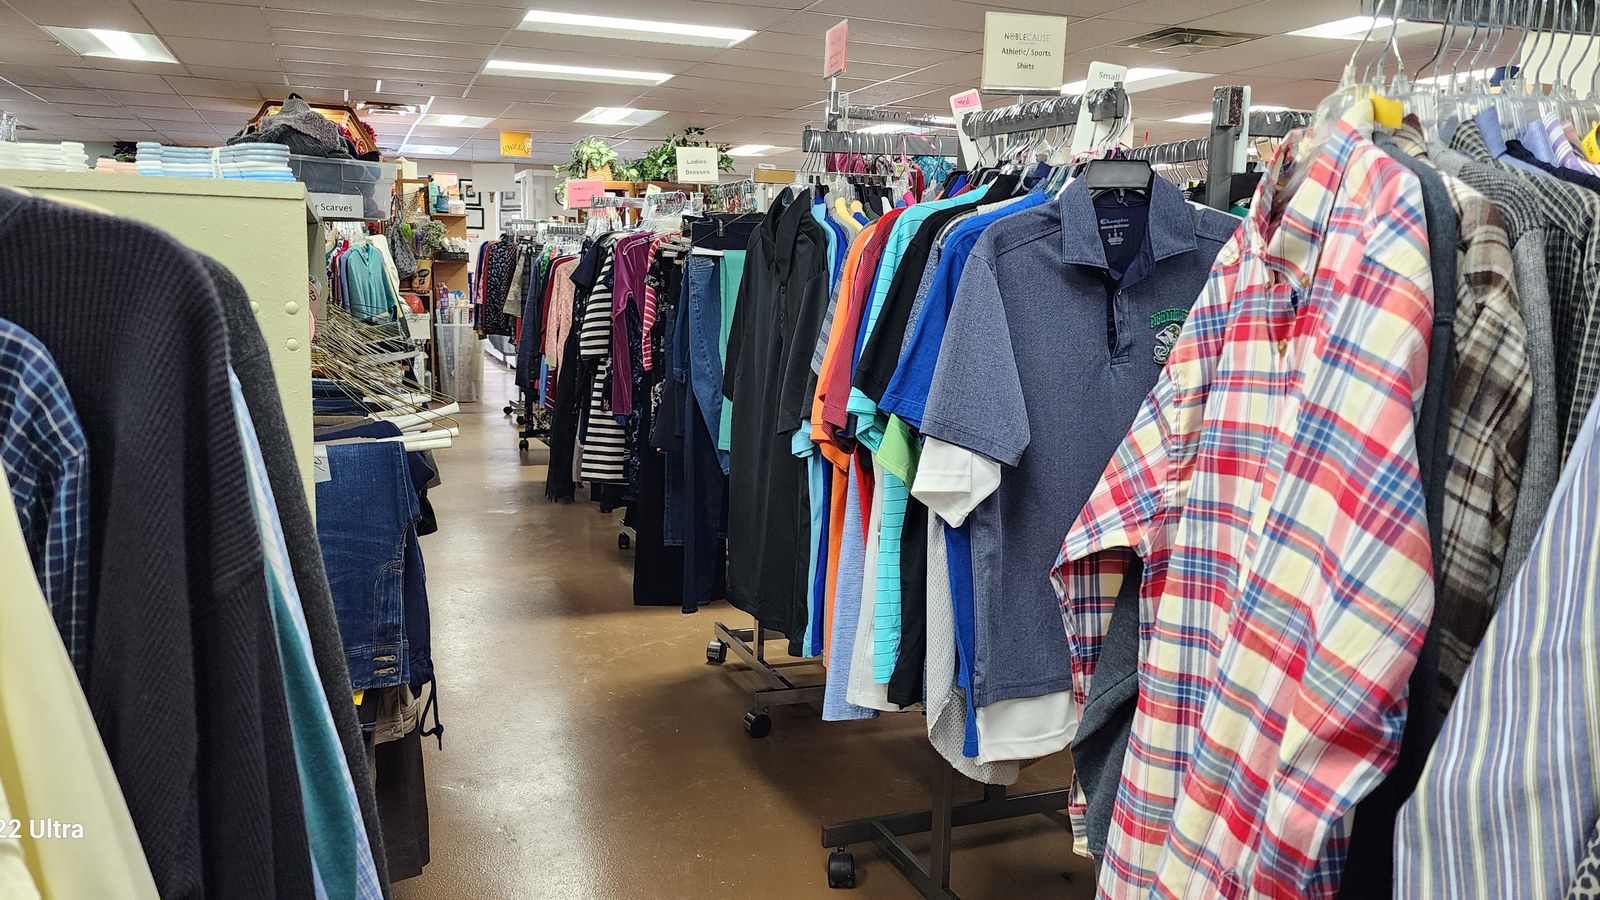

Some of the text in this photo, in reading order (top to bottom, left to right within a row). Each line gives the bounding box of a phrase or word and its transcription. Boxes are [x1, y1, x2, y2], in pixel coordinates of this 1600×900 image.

[1030, 49, 1051, 57] Sports
[1016, 62, 1035, 70] Shirts
[1098, 71, 1121, 81] Small
[320, 203, 353, 212] Scarves
